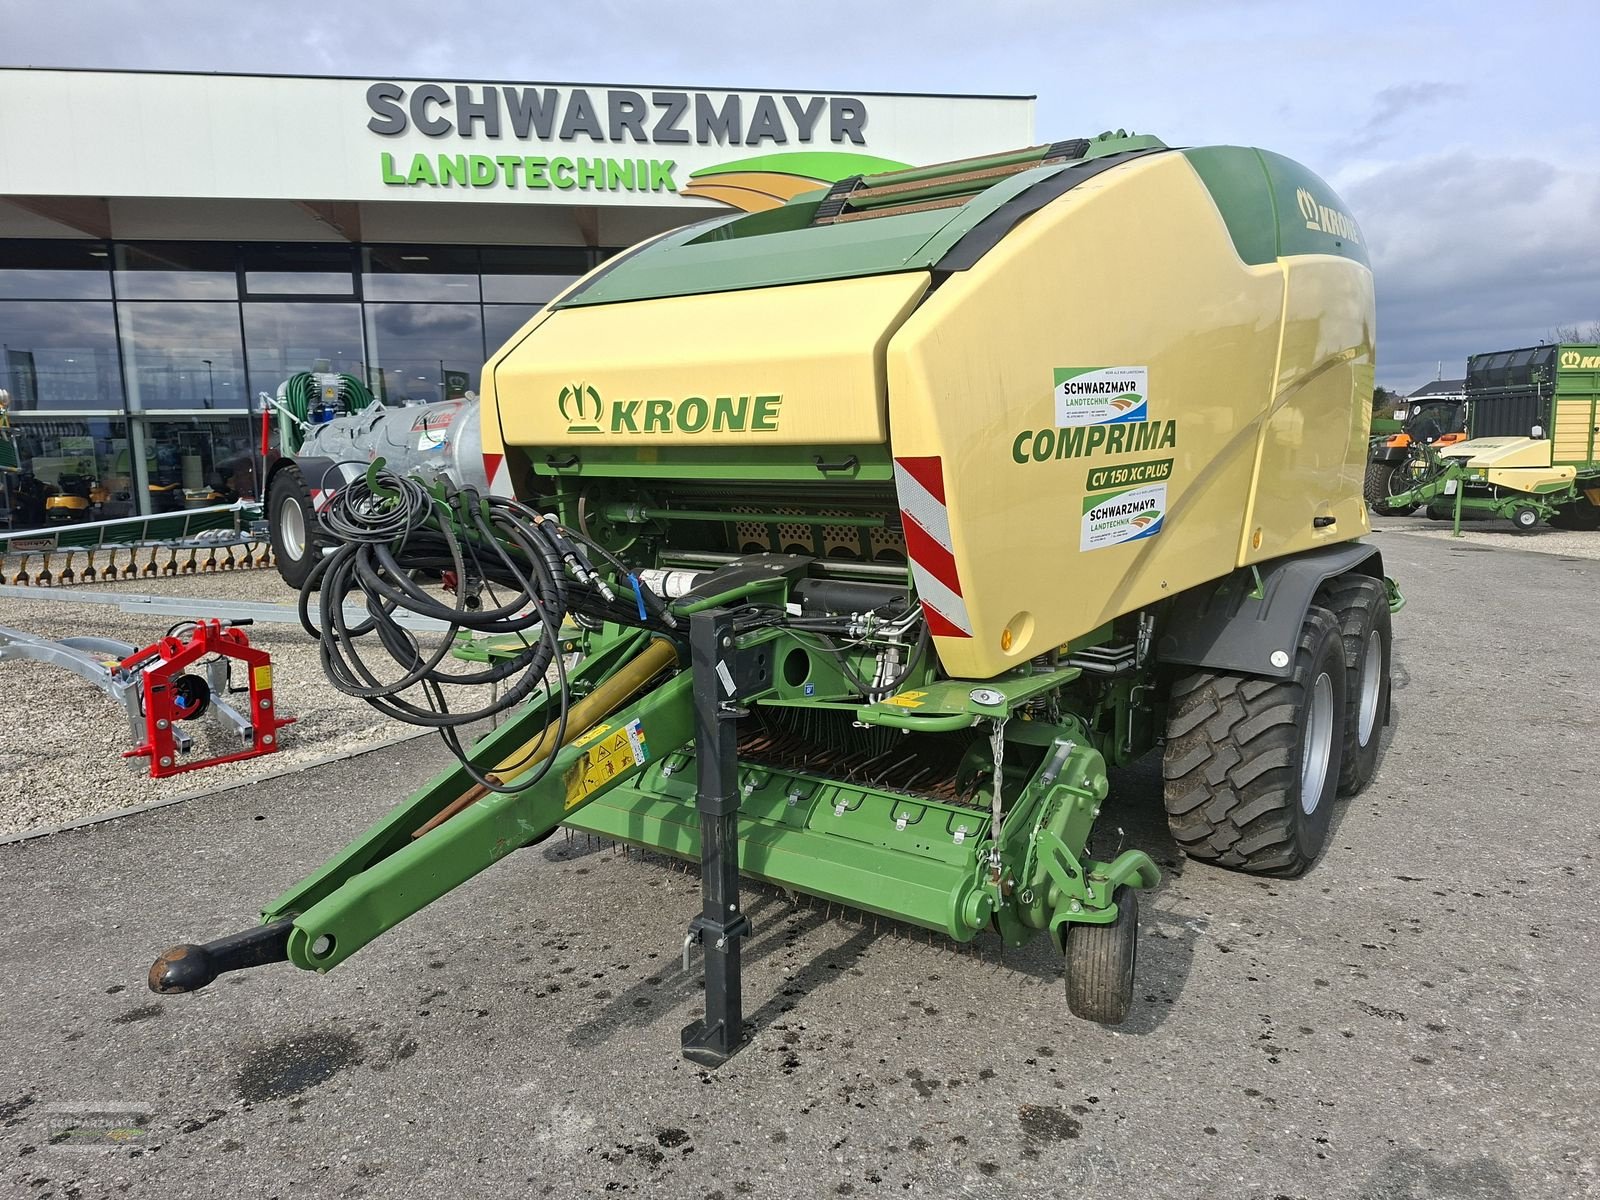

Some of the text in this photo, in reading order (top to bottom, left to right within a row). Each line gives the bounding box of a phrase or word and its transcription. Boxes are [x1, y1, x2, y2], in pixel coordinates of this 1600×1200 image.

[367, 83, 868, 144] SCHWARZMAYR
[381, 152, 677, 192] LANDTECHNIK
[1319, 205, 1359, 244] KRONE
[1064, 381, 1136, 394] SCHWARZMAYR
[1066, 398, 1109, 406] LANDTECHNIK
[611, 395, 782, 433] KRONE
[1012, 420, 1176, 464] COMPRIMA
[1092, 463, 1169, 486] CV 150 XC PLUS
[1090, 499, 1155, 521] SCHWARZMAYR
[1090, 518, 1130, 532] LANDTECHNIK
